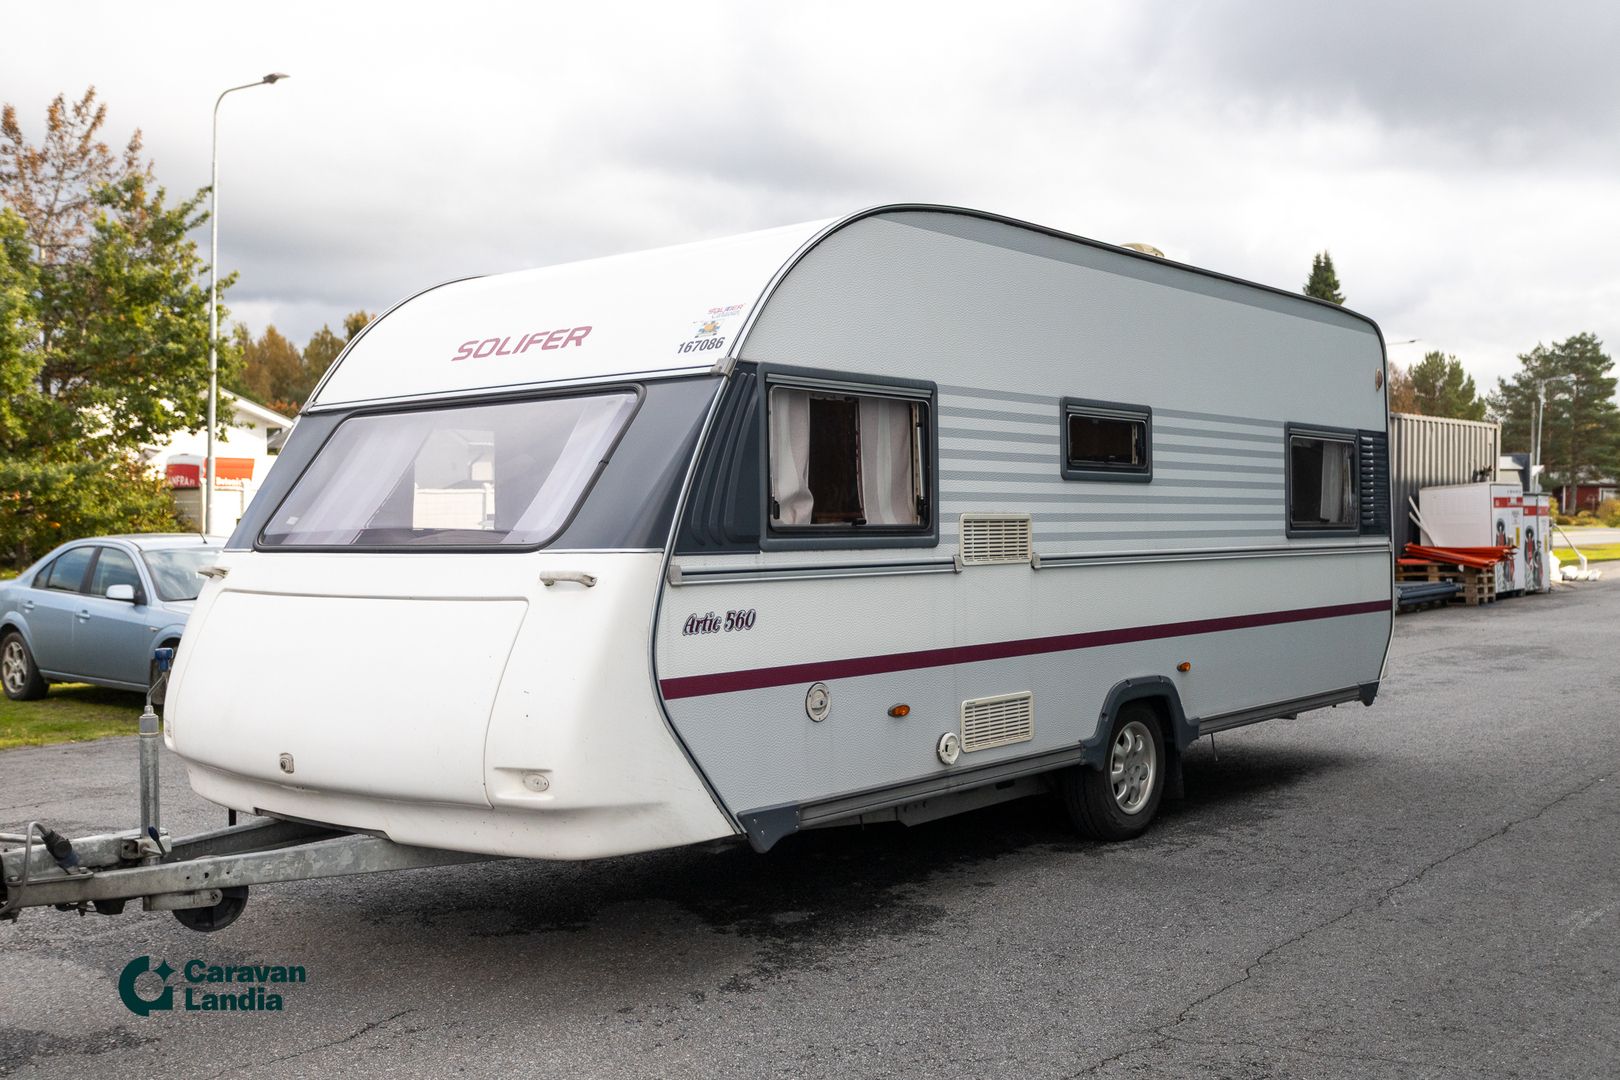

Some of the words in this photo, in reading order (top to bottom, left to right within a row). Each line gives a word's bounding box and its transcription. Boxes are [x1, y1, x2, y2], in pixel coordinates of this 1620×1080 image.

[451, 326, 593, 361] SOLIFER
[678, 337, 725, 354] 167086
[682, 611, 722, 636] Artic
[724, 608, 757, 632] 560
